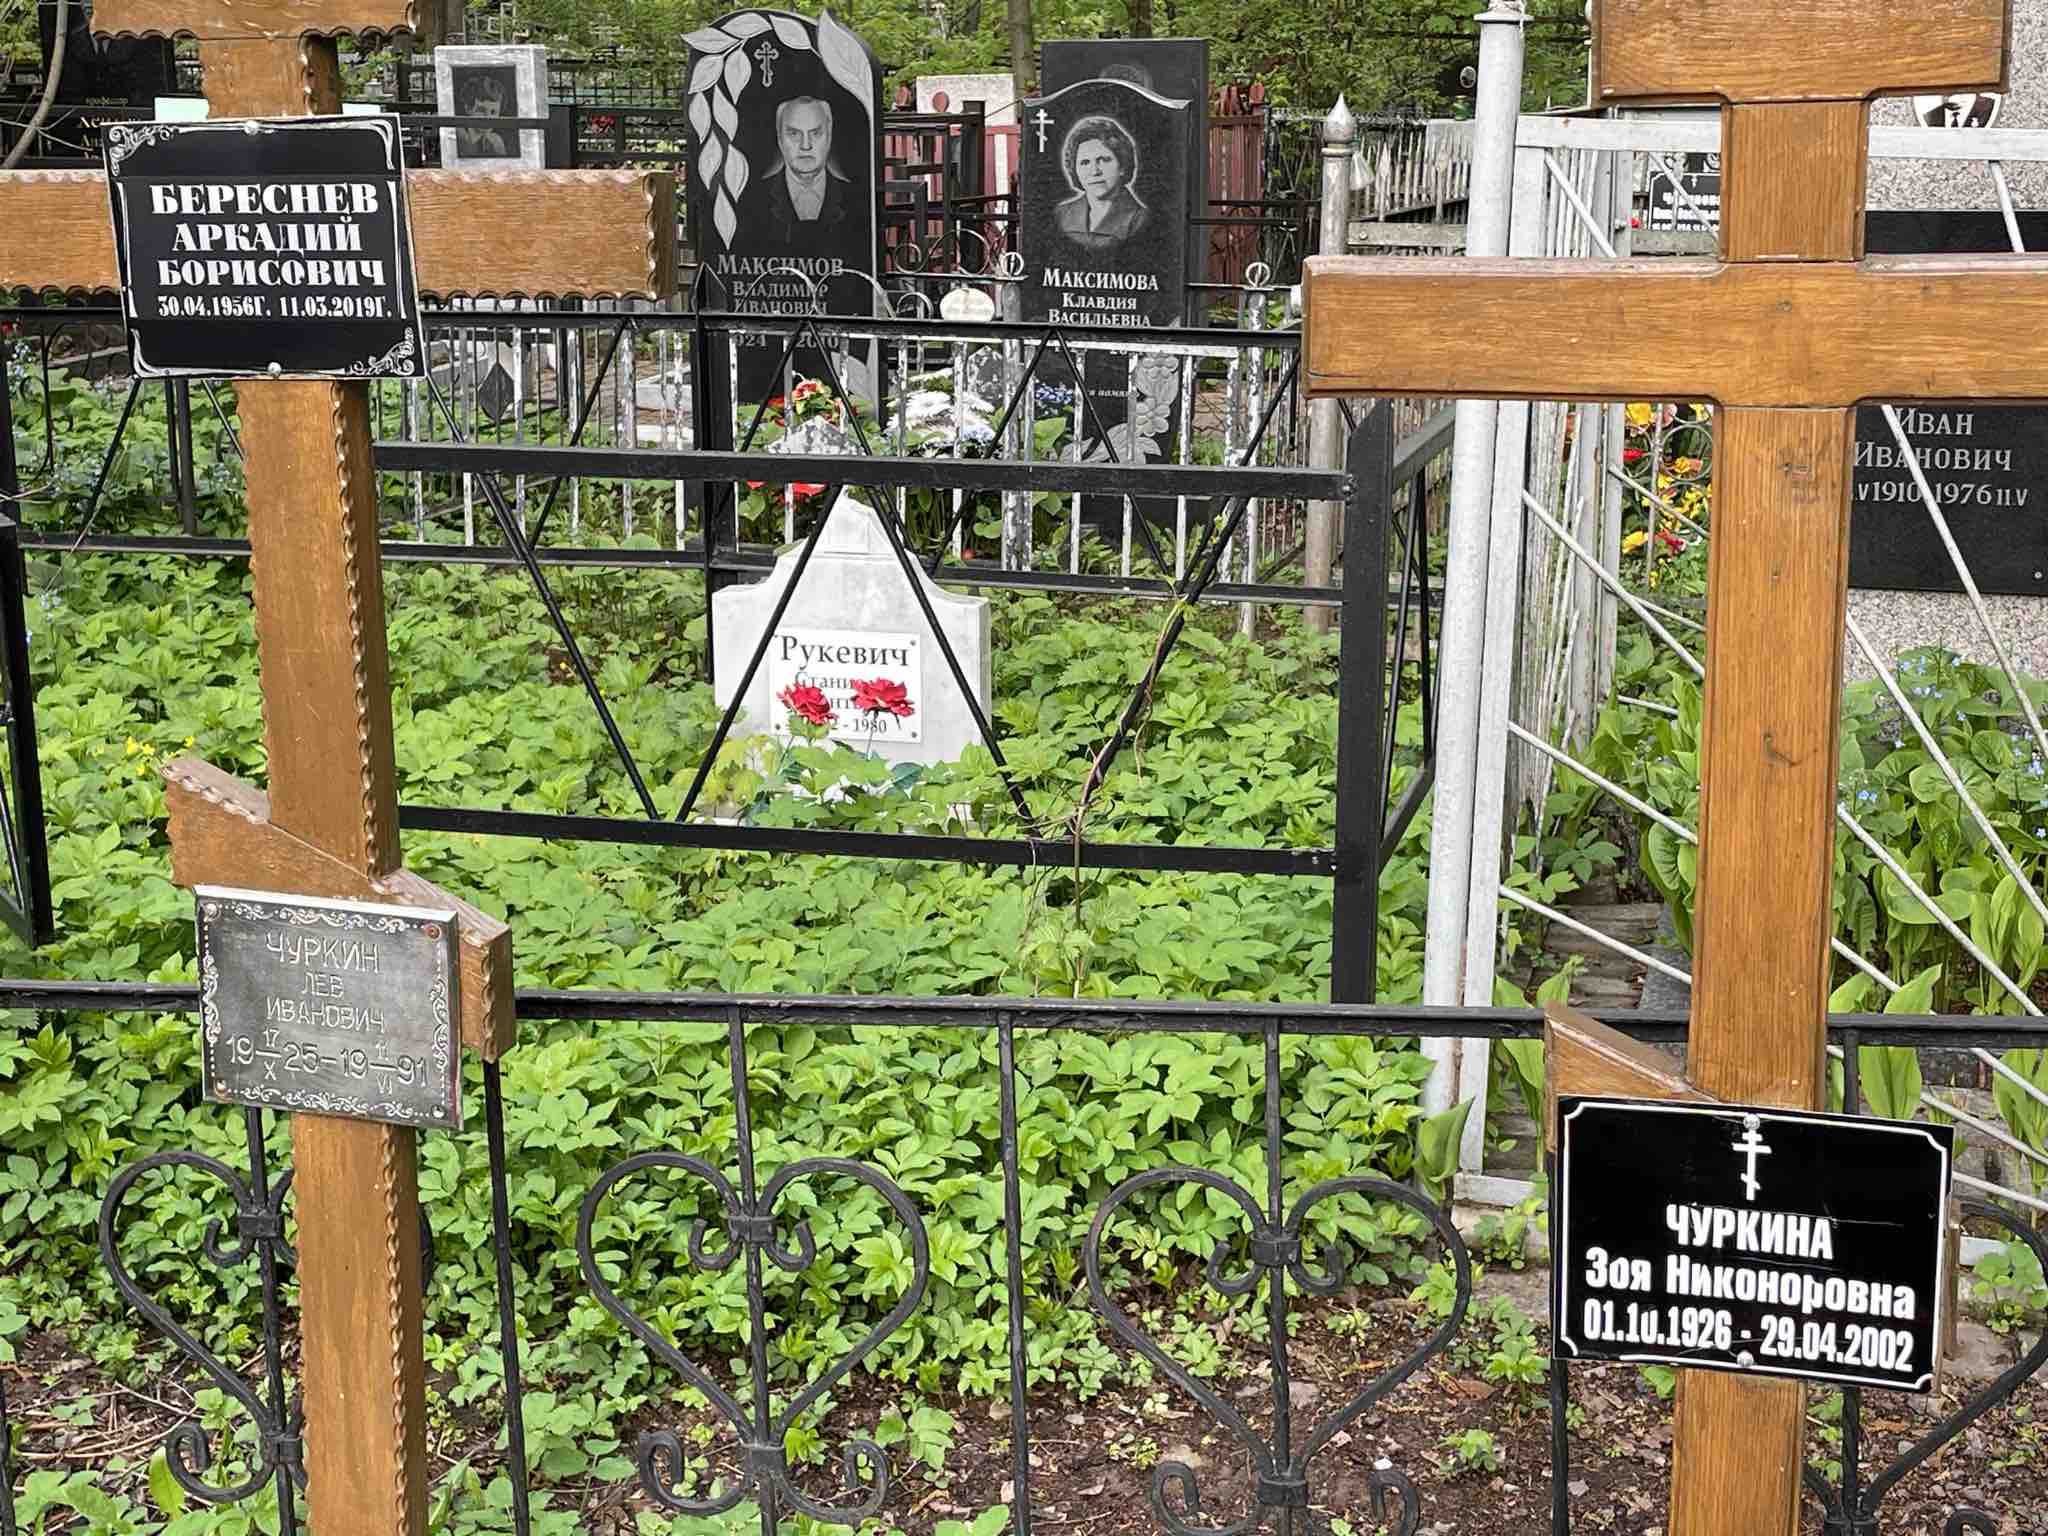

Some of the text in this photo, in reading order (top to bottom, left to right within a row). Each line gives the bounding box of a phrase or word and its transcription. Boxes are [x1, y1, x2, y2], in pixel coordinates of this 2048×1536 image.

[150, 183, 379, 214] БЕРЕСНЕВ
[172, 216, 362, 256] АРКАДИЙ
[157, 260, 386, 286] БОРИСОВИЧ
[1043, 268, 1159, 290] МАКСИМОВА
[158, 295, 392, 318] 30.04.1956Г. 11.03.2019Г.
[1895, 408, 1974, 436] ИВАН
[780, 635, 909, 671] Рукевич
[853, 718, 887, 733] 1980
[265, 931, 380, 973] ЧУРКИН
[302, 972, 344, 998] ЛЕВ
[266, 996, 385, 1034] ИВАНОВИЧ
[1666, 1203, 1833, 1260] ЧУРКИНА
[1585, 1246, 1916, 1320] Зоя Никоноровна
[1760, 1315, 1914, 1372] 29.04.2002
